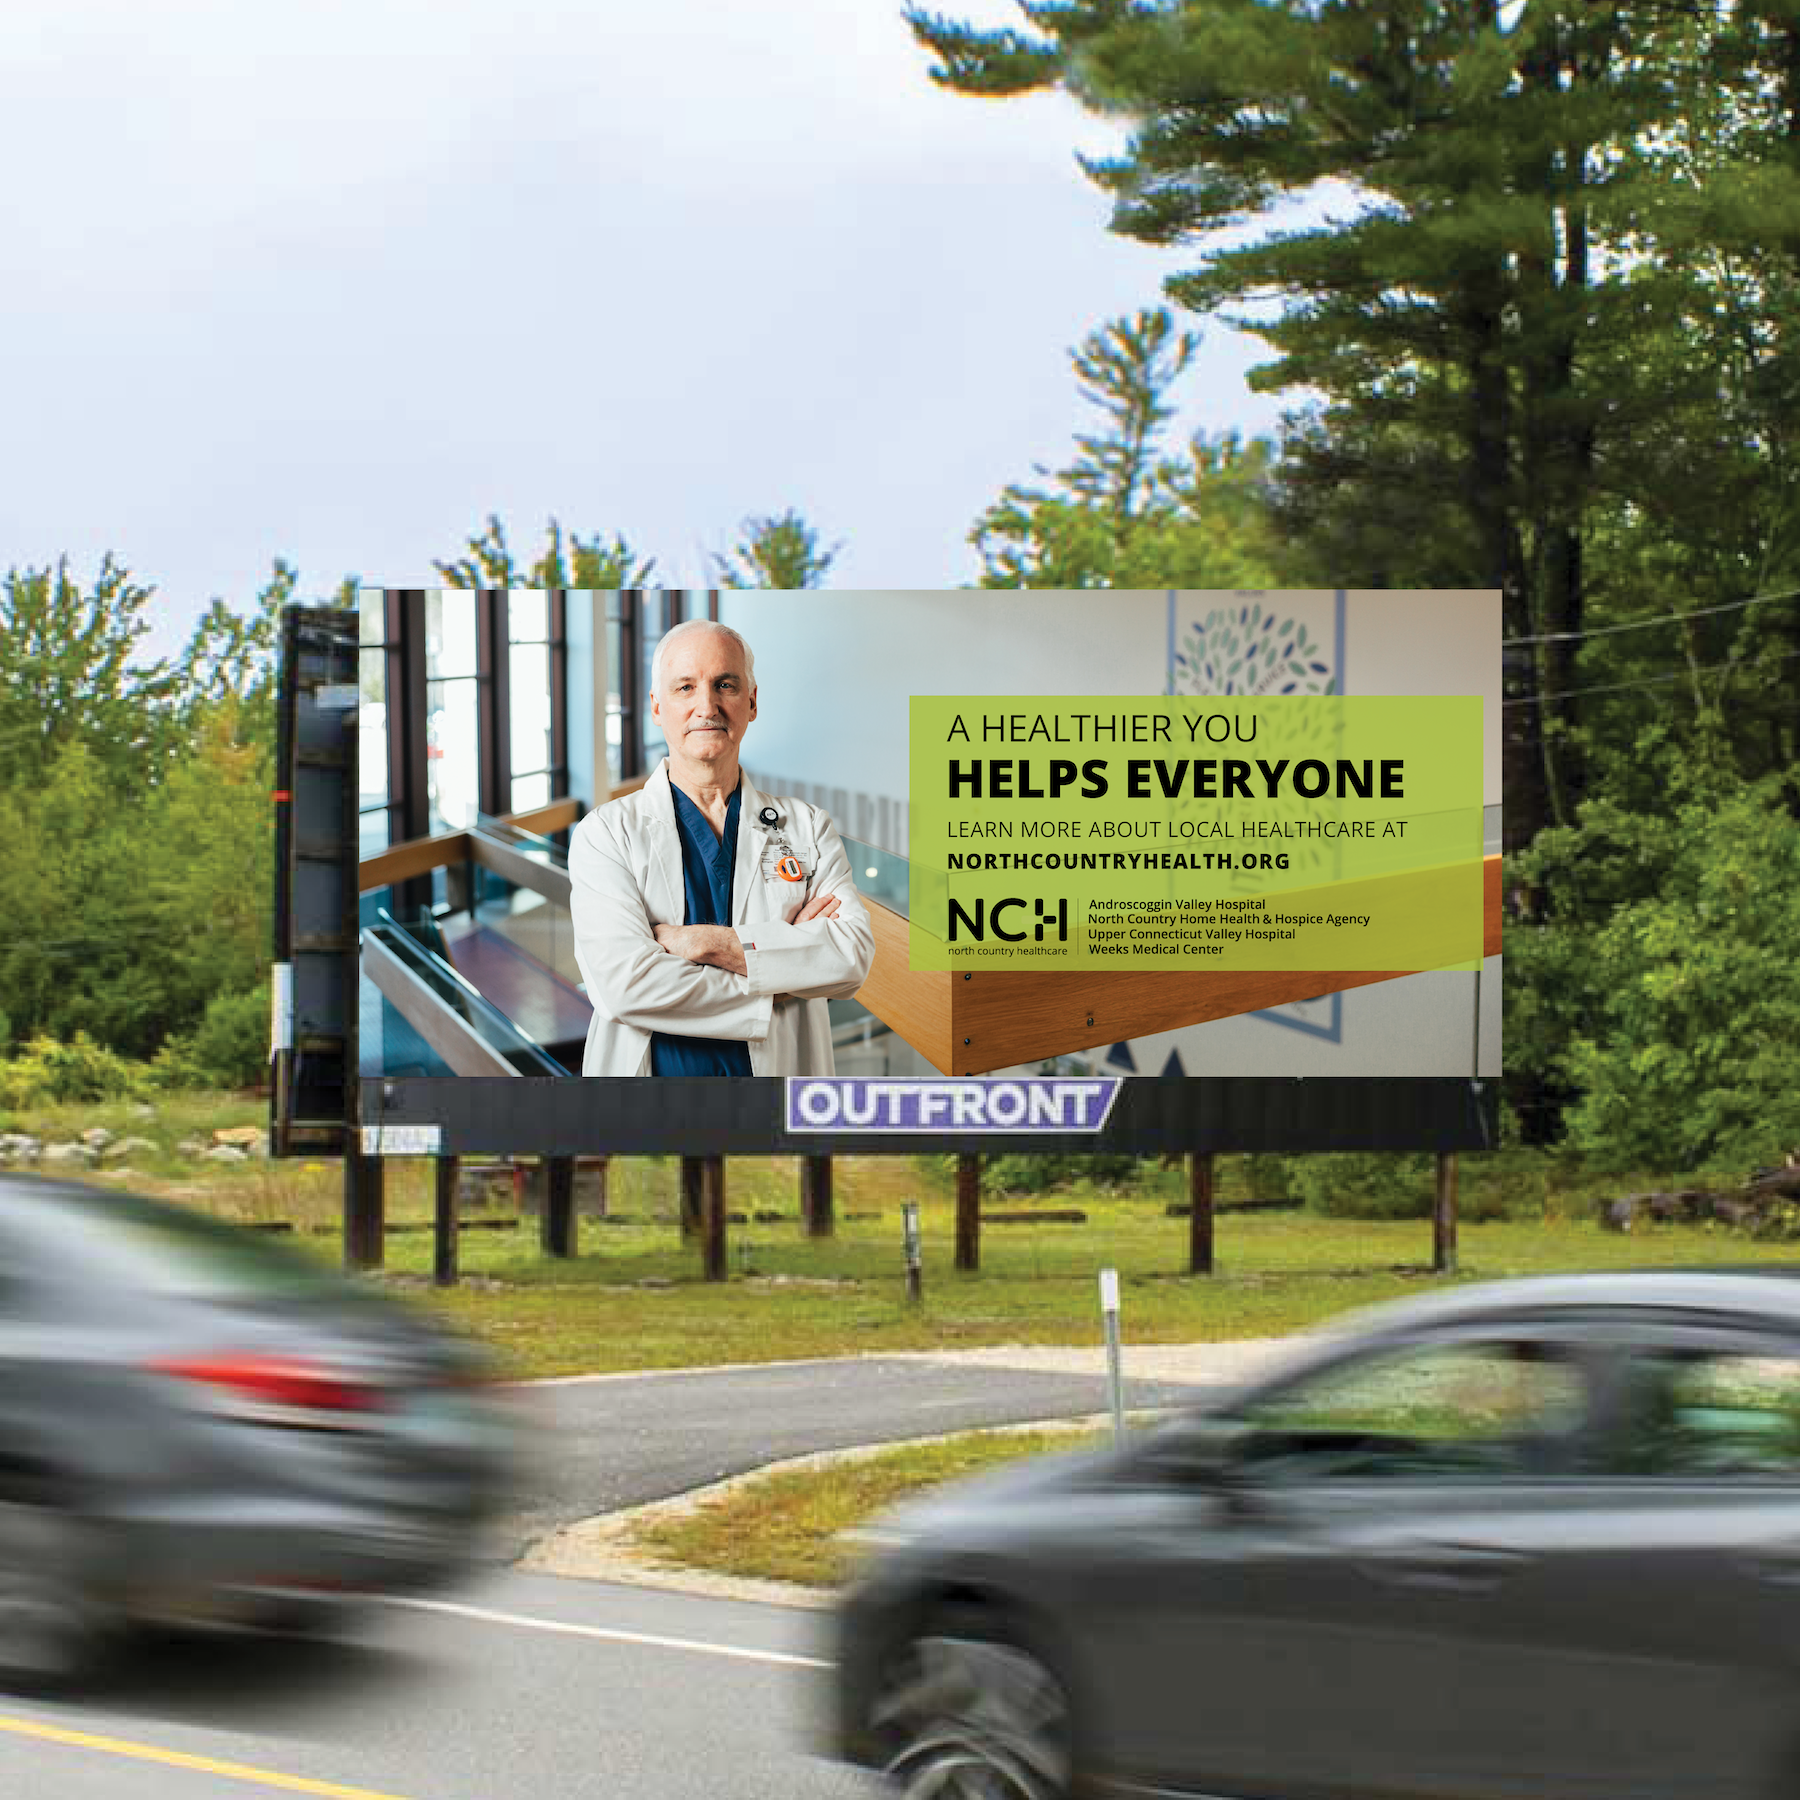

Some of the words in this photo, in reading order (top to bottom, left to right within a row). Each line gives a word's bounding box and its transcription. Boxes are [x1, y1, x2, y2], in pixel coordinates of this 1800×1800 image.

[947, 715, 970, 742] A
[983, 715, 1172, 742] HEALTHIER
[1182, 715, 1257, 742] YOU
[948, 759, 1109, 799] HELPS
[1127, 759, 1404, 799] EVERYONE
[948, 821, 1013, 838] LEARN
[1021, 821, 1082, 838] MORE
[1088, 821, 1161, 838] ABOUT
[1168, 821, 1235, 838] LOCAL
[1242, 821, 1376, 838] HEALTHCARE
[1382, 821, 1409, 838] AT
[947, 853, 1290, 870] NORTHCOUNTRYHEALTH.ORG
[1089, 899, 1172, 912] Androscoggin
[1176, 899, 1212, 912] Valley
[1215, 899, 1266, 912] Hospital
[948, 898, 1068, 942] NCH
[1088, 914, 1124, 924] North
[1127, 914, 1177, 926] Country
[1180, 914, 1216, 924] Home
[1219, 914, 1260, 924] Health
[1262, 914, 1273, 924] &
[1275, 914, 1323, 926] Hospice
[1326, 914, 1371, 926] Agency
[1088, 929, 1127, 942] Upper
[1129, 929, 1202, 940] Connecticut
[1206, 929, 1242, 942] Valley
[1245, 929, 1296, 942] Hospital
[948, 947, 975, 955] north
[977, 947, 1015, 957] country
[1016, 947, 1068, 955] healthcare
[1088, 943, 1129, 955] Weeks
[1132, 943, 1180, 955] Medical
[1183, 943, 1224, 955] Center
[799, 1082, 1102, 1125] OUTFRONT
